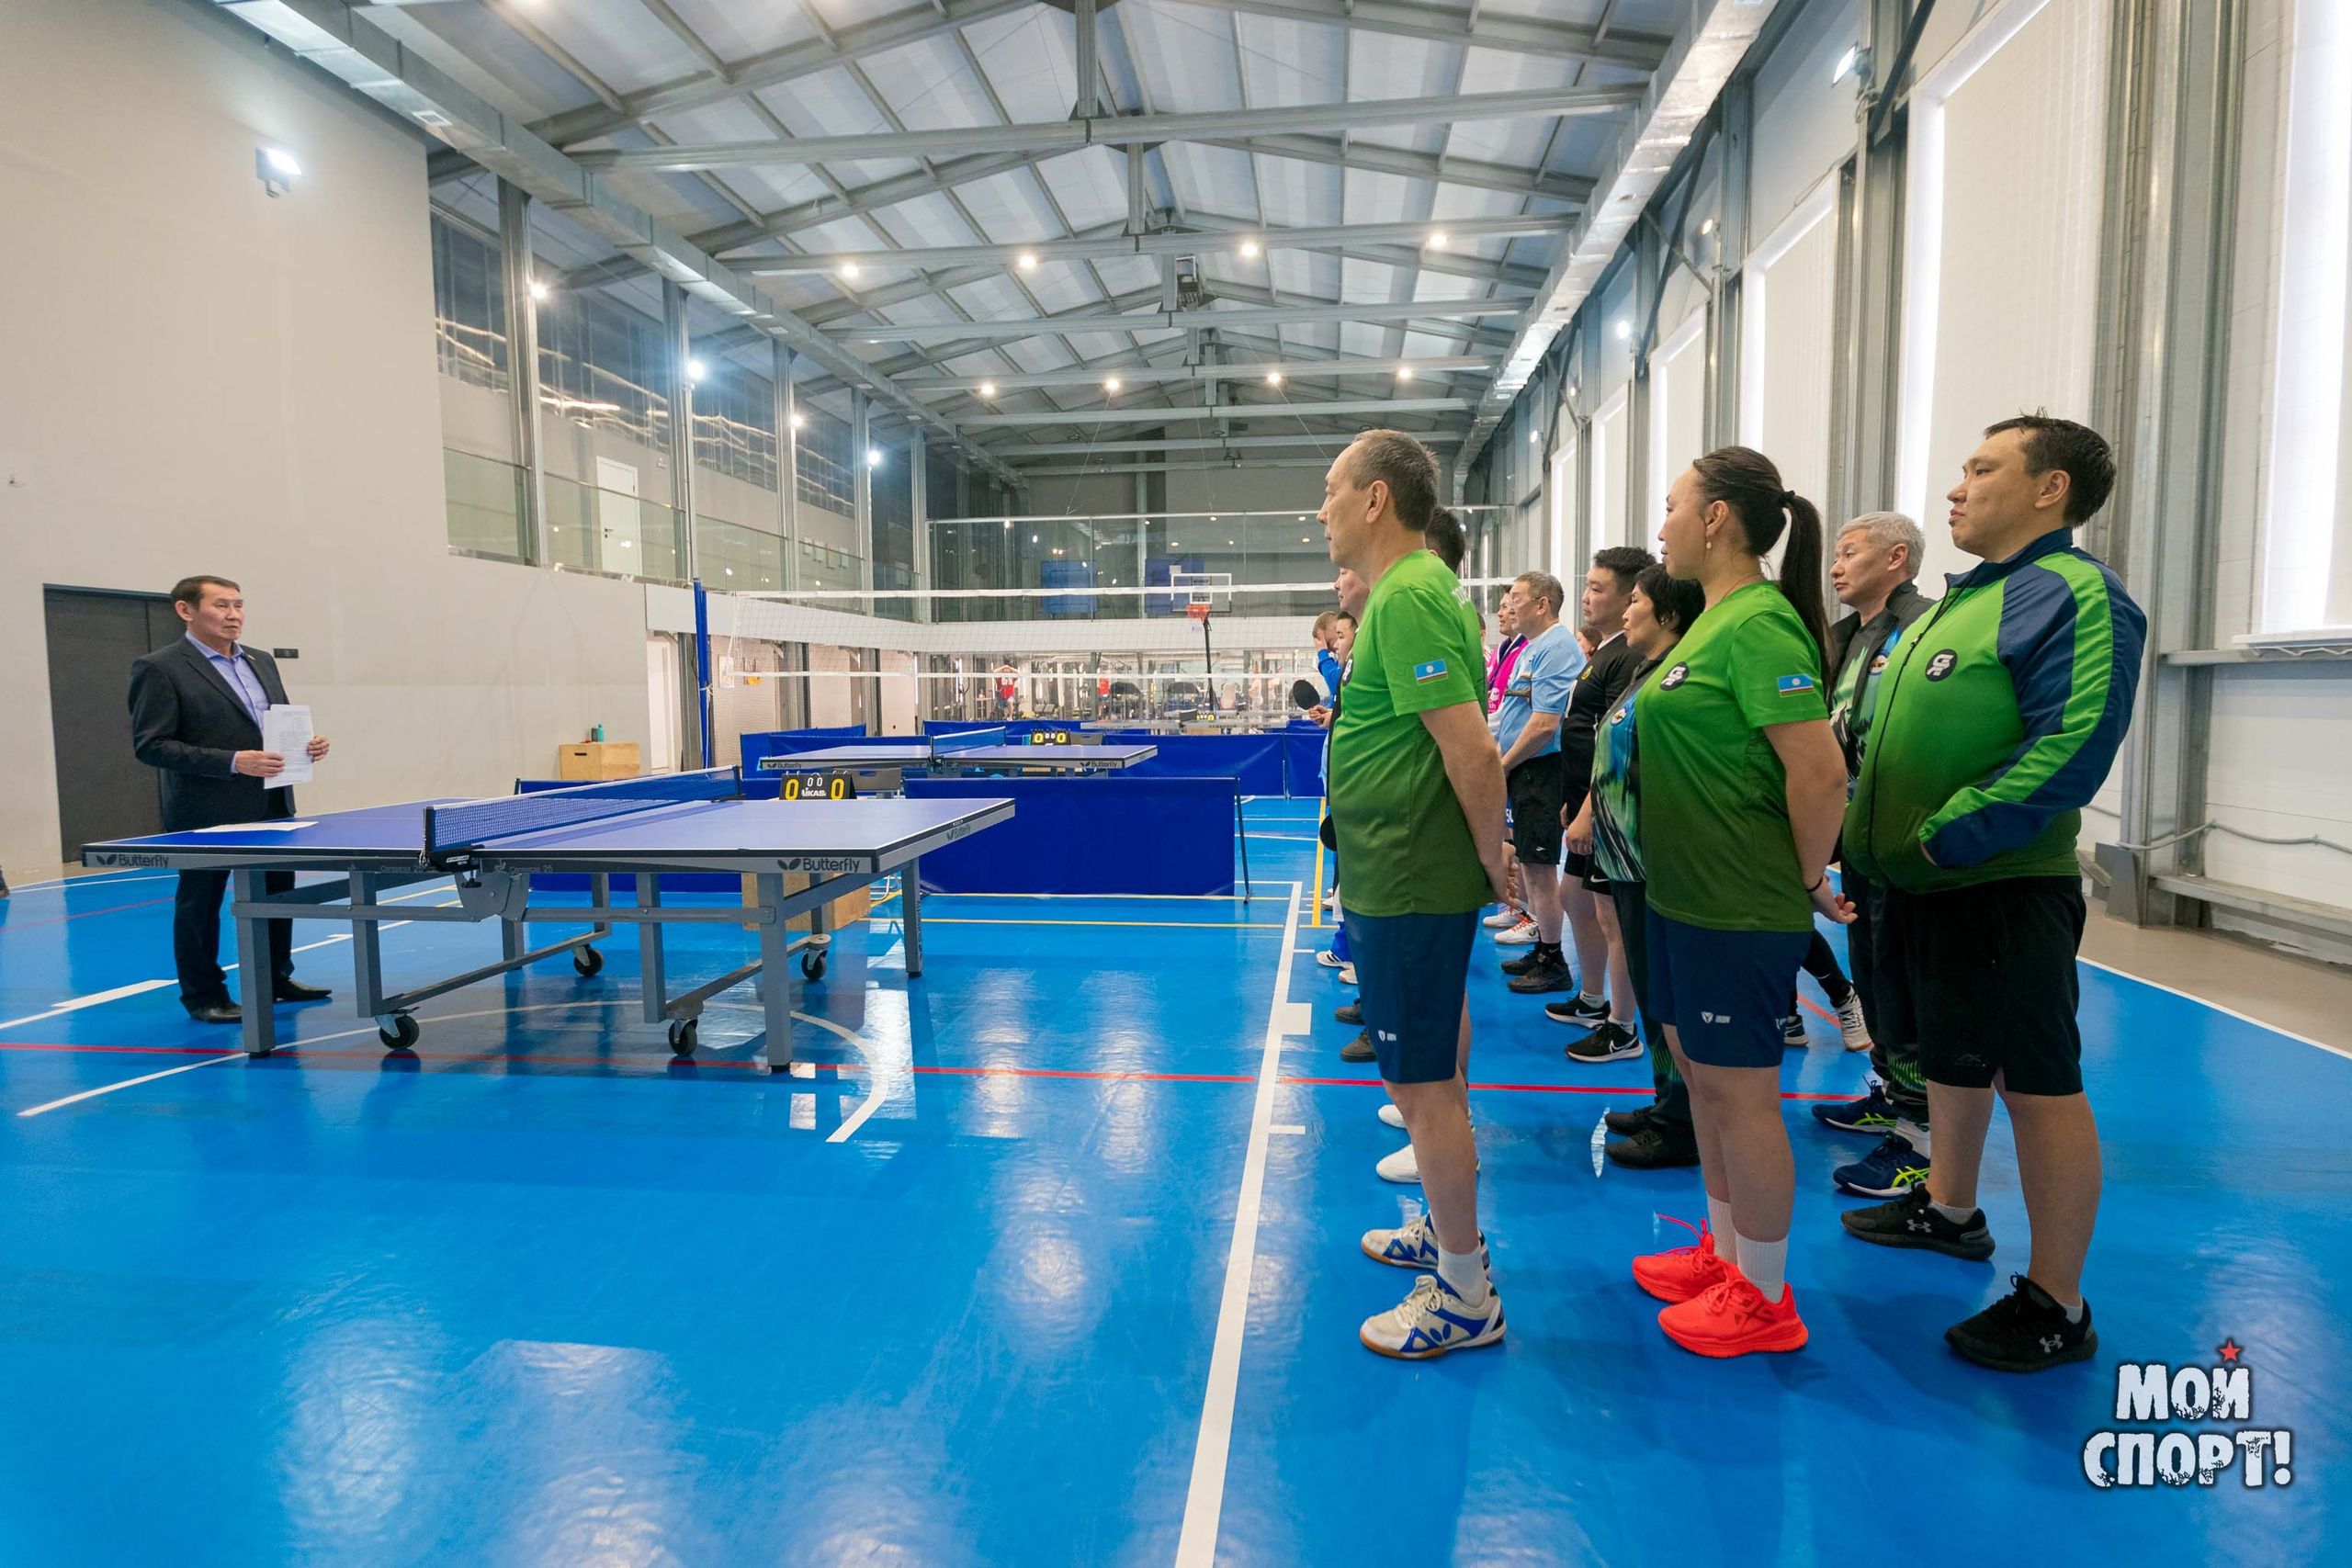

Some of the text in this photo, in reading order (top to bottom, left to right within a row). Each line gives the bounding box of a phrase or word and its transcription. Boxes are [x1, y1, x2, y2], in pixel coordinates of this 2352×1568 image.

[785, 778, 799, 801] 0
[831, 778, 844, 801] 0
[119, 853, 169, 868] Butterfly
[802, 857, 860, 874] Butterfly
